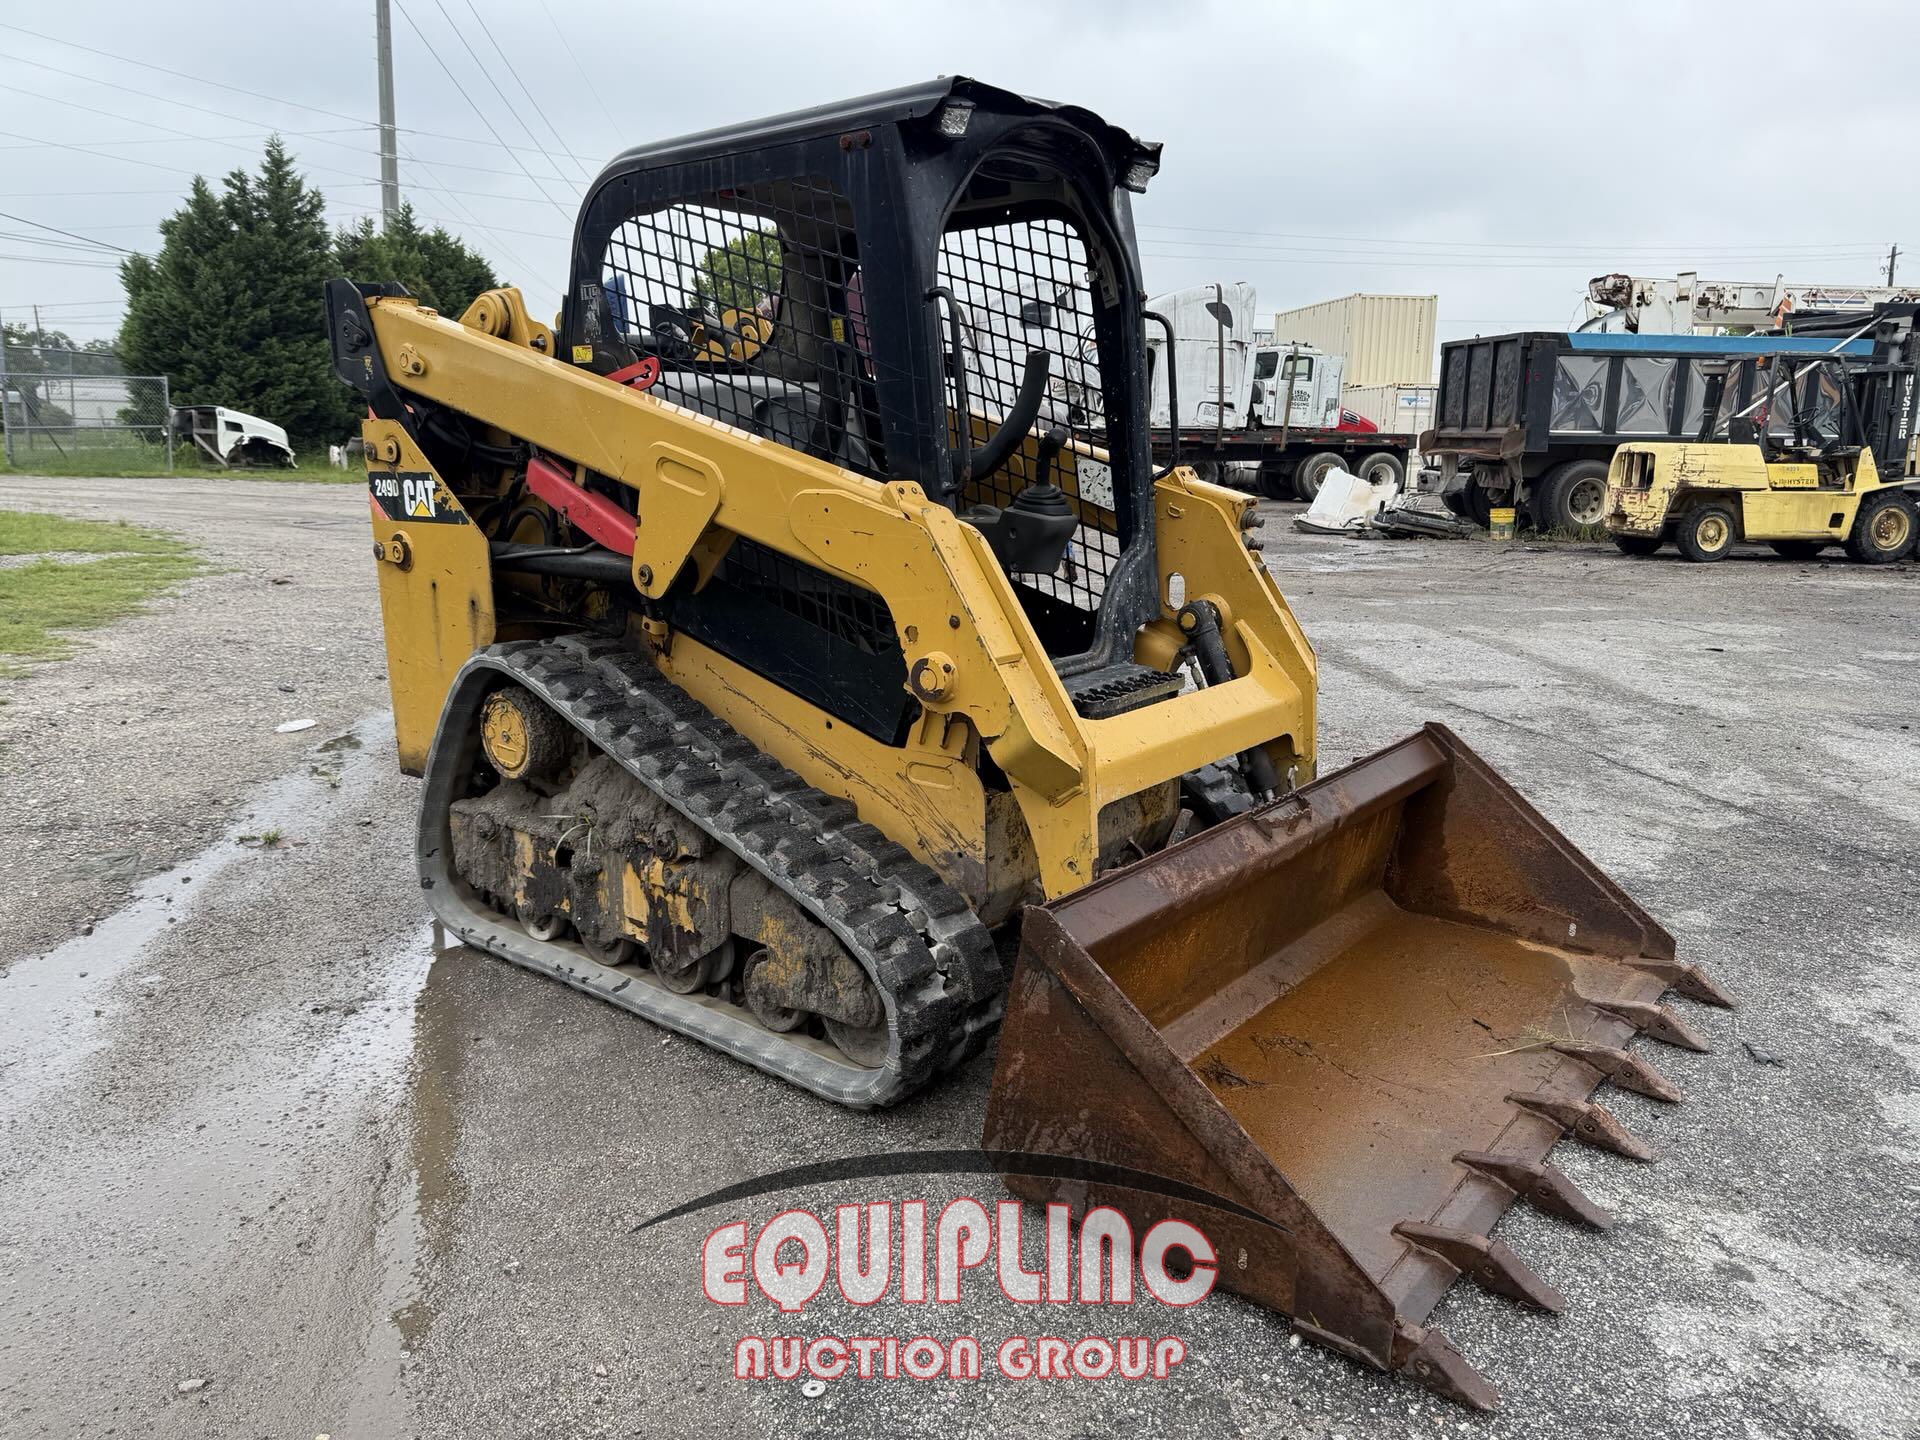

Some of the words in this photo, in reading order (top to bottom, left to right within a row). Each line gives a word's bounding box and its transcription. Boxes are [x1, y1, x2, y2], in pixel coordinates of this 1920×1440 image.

[1898, 374, 1915, 440] HYSTER
[375, 479, 400, 497] 249D
[403, 479, 436, 517] CAT
